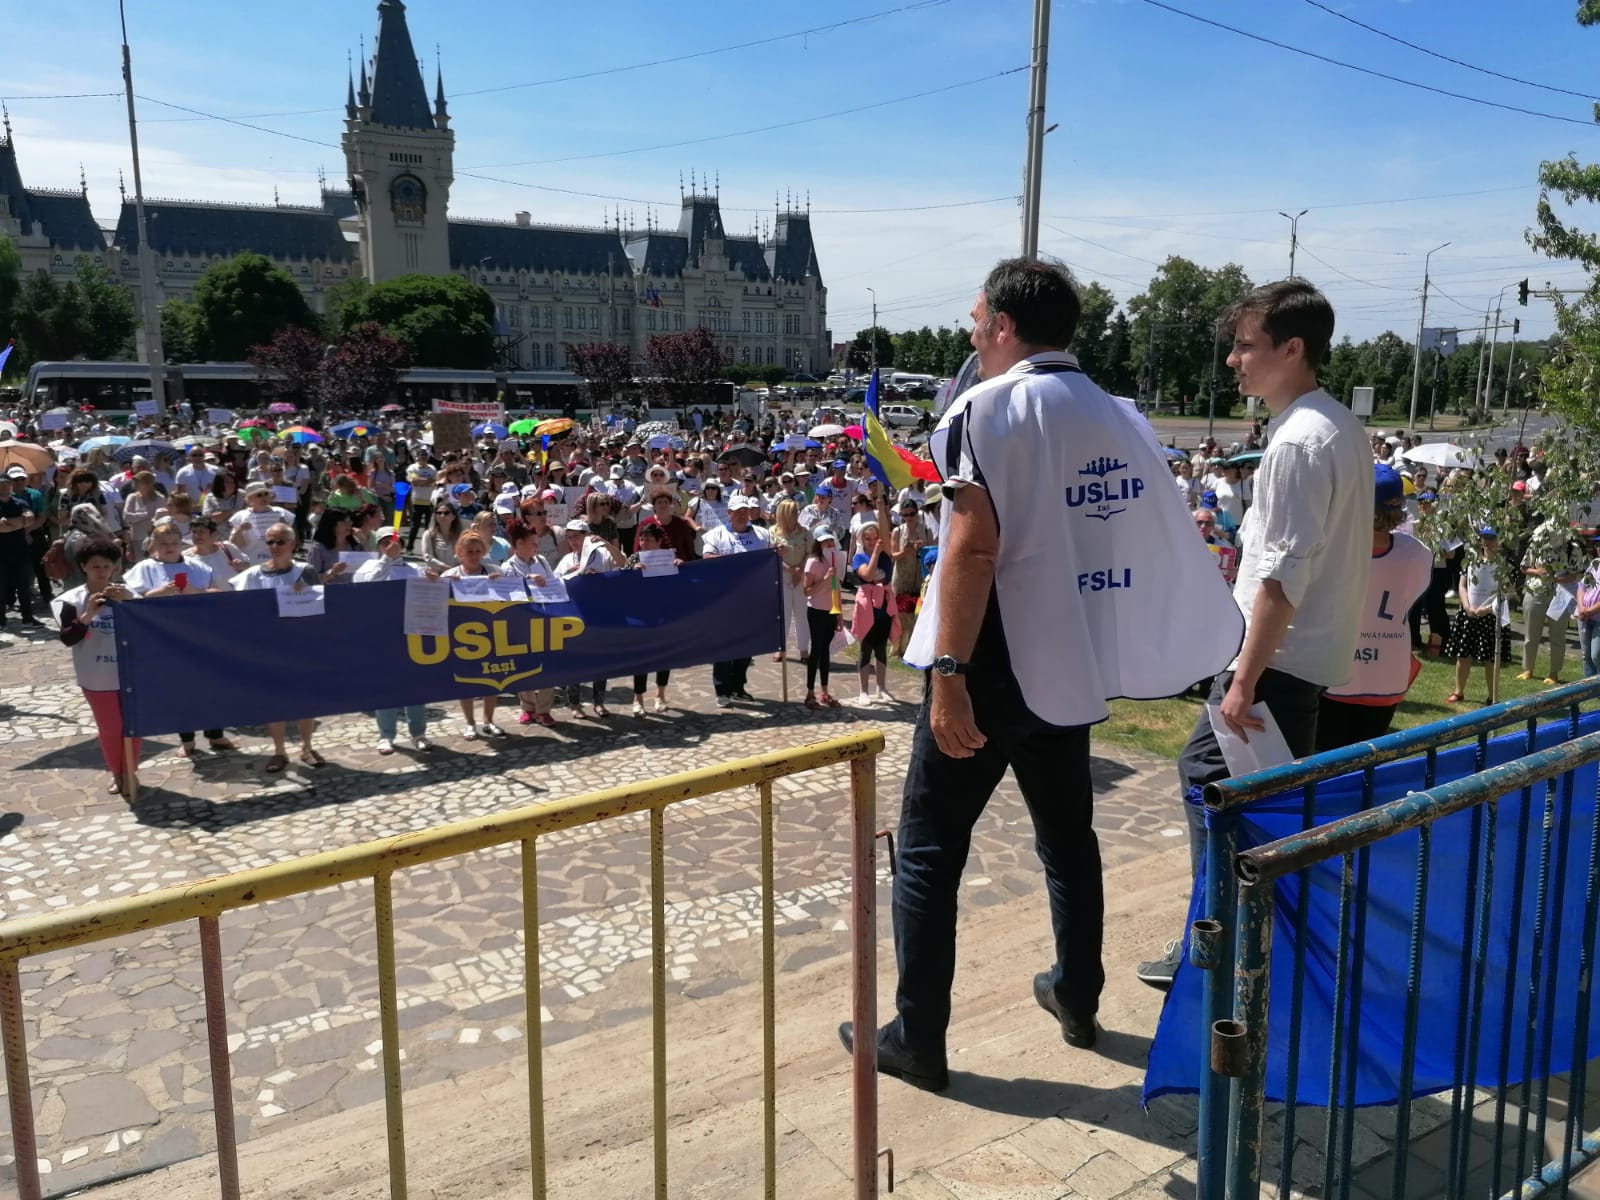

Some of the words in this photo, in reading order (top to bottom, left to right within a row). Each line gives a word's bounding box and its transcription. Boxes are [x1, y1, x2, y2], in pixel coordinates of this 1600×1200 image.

[1065, 478, 1144, 507] USLIP
[1078, 568, 1131, 595] FSLI
[91, 621, 113, 629] USL
[407, 616, 585, 665] USLIP
[1353, 648, 1378, 664] AȘI
[481, 659, 516, 675] Iași
